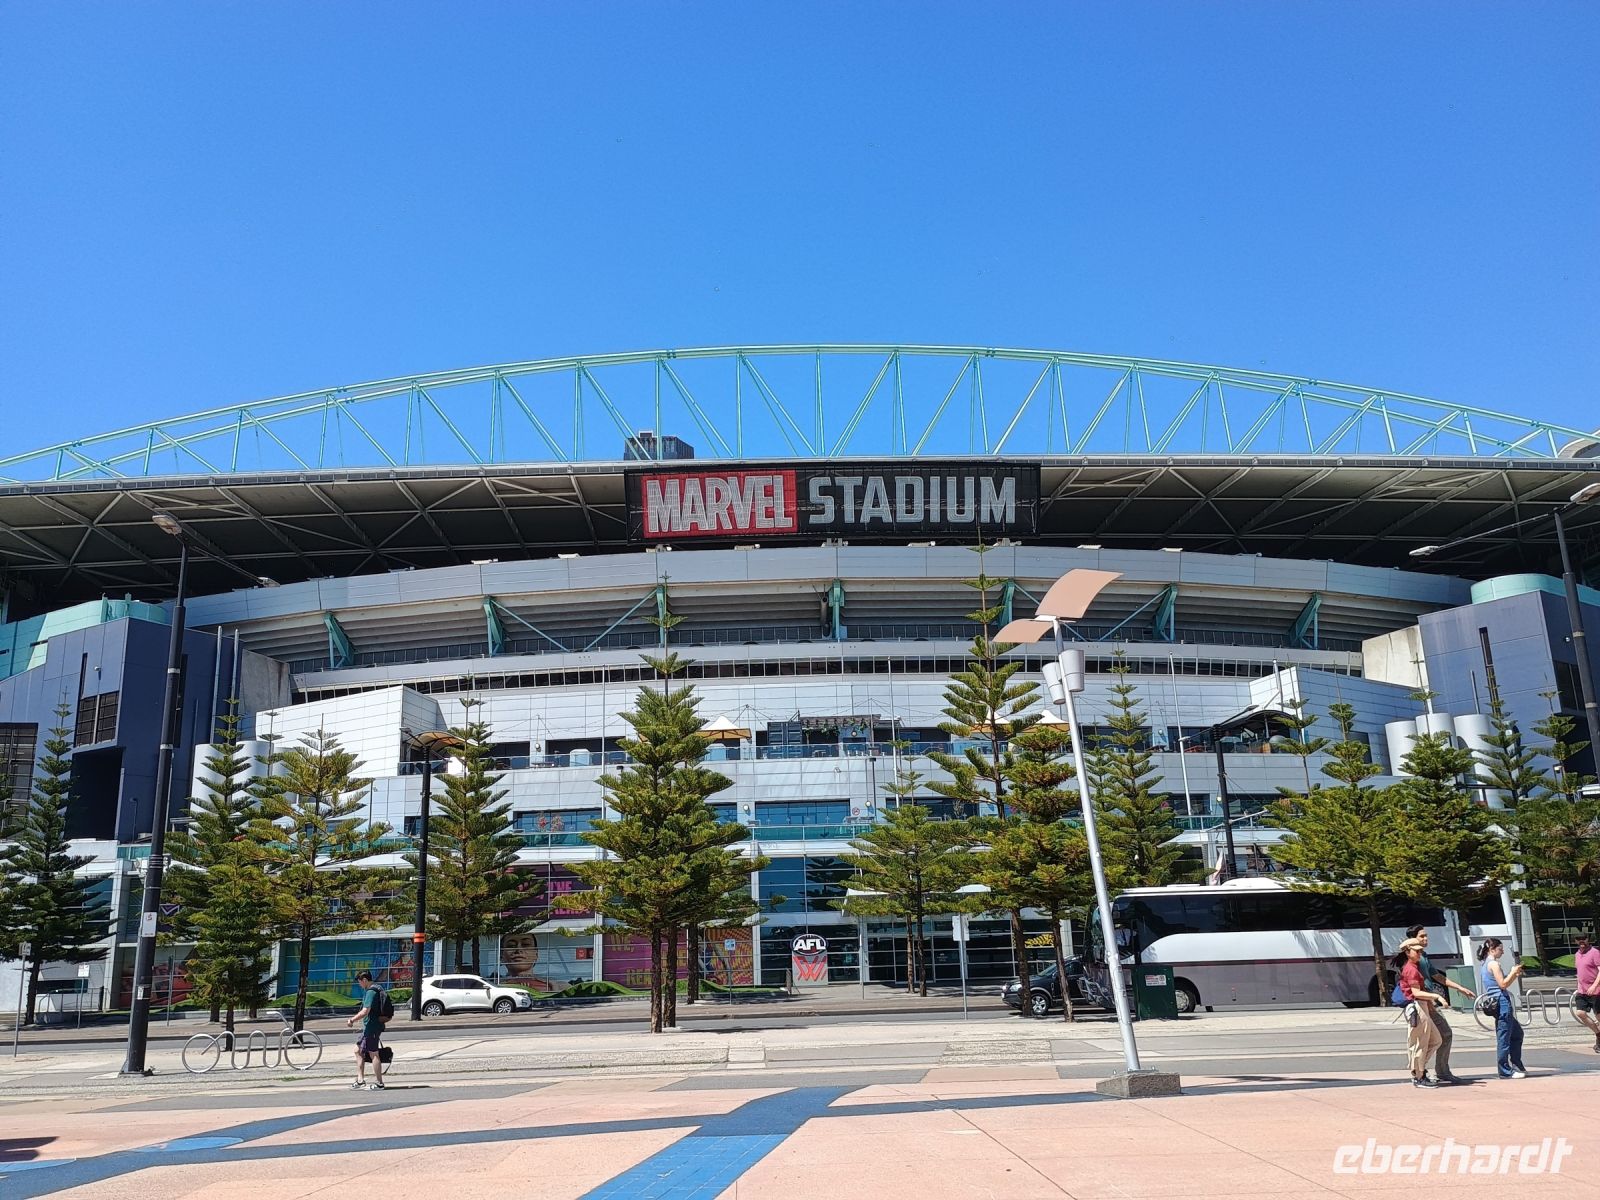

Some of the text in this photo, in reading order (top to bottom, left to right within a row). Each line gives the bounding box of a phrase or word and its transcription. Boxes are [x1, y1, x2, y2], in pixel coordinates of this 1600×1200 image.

[646, 475, 1016, 532] MARVEL STADIUM
[793, 939, 827, 950] AFL
